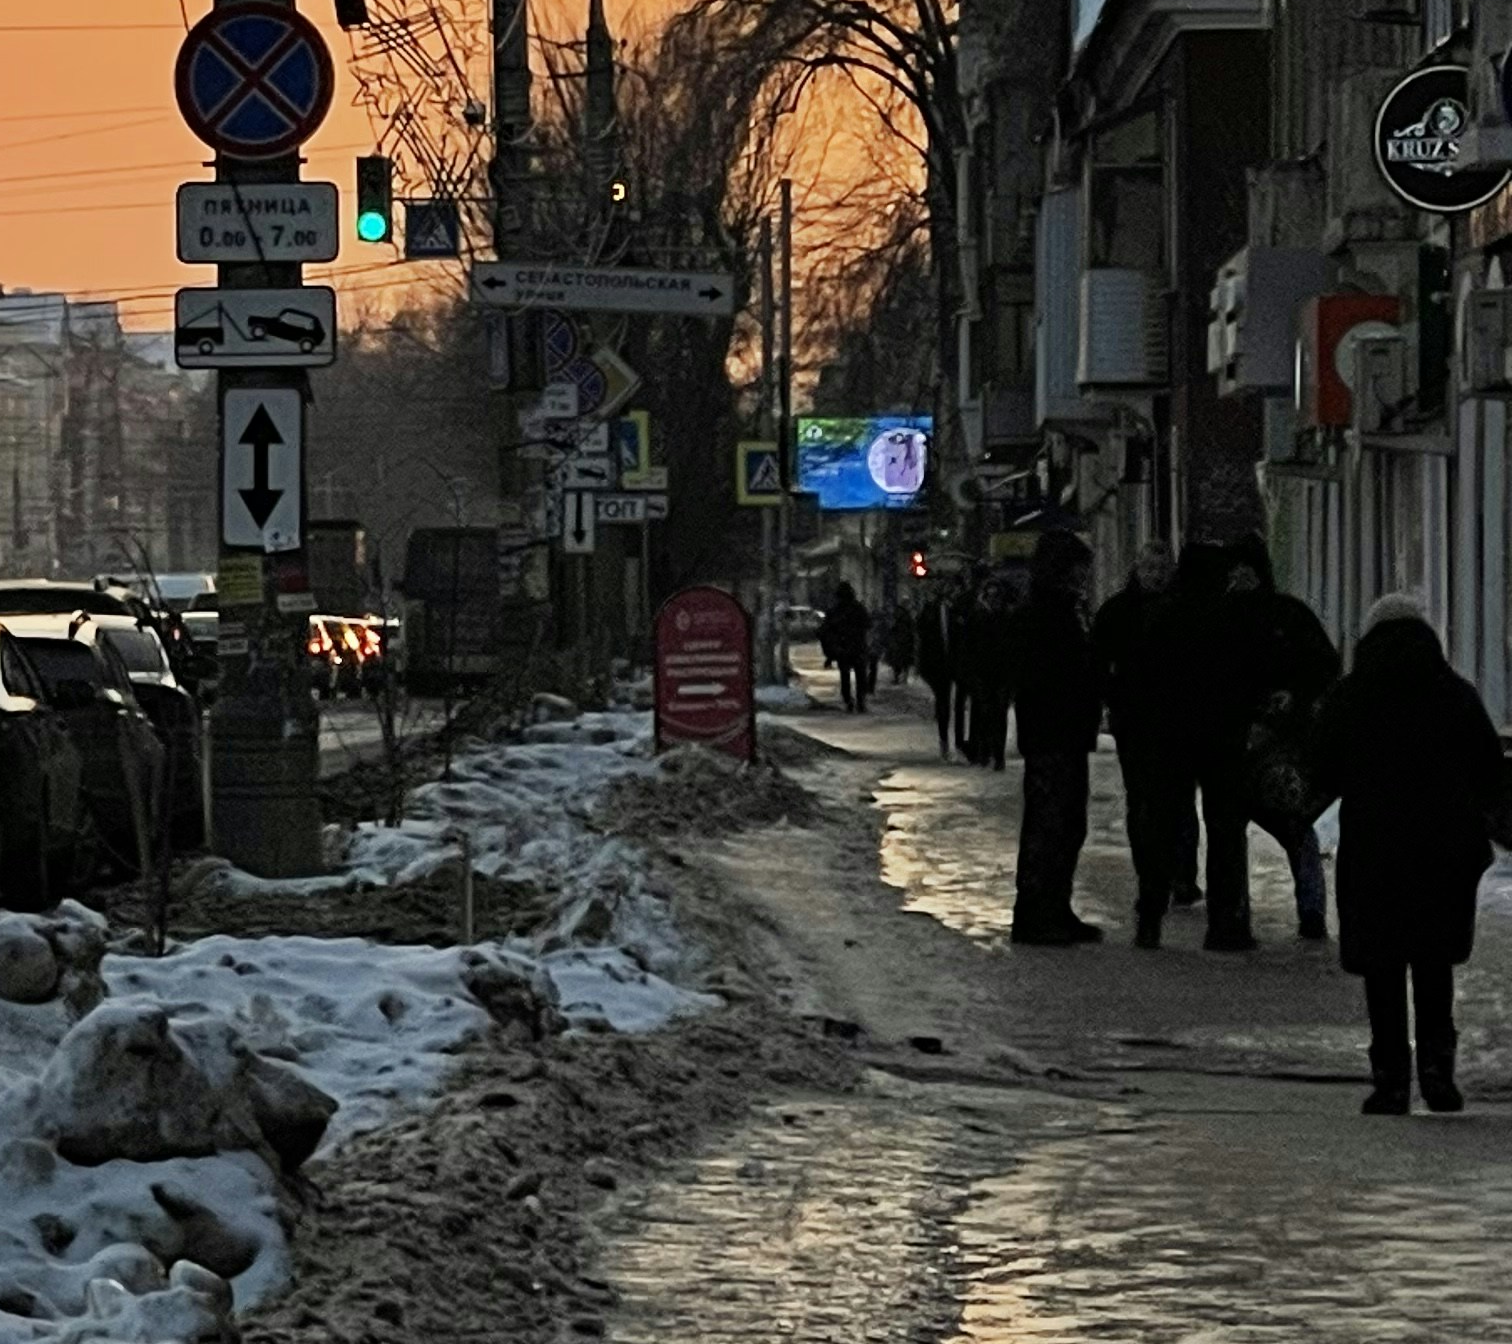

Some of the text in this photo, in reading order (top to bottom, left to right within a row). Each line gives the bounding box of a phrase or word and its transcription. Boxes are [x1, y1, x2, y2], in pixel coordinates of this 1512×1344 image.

[203, 197, 312, 216] ПЯТНИЦА
[199, 225, 246, 247] 0.00
[271, 225, 318, 247] 7.00
[514, 269, 691, 292] СЕВАСТОПОЛЬСКАЯ
